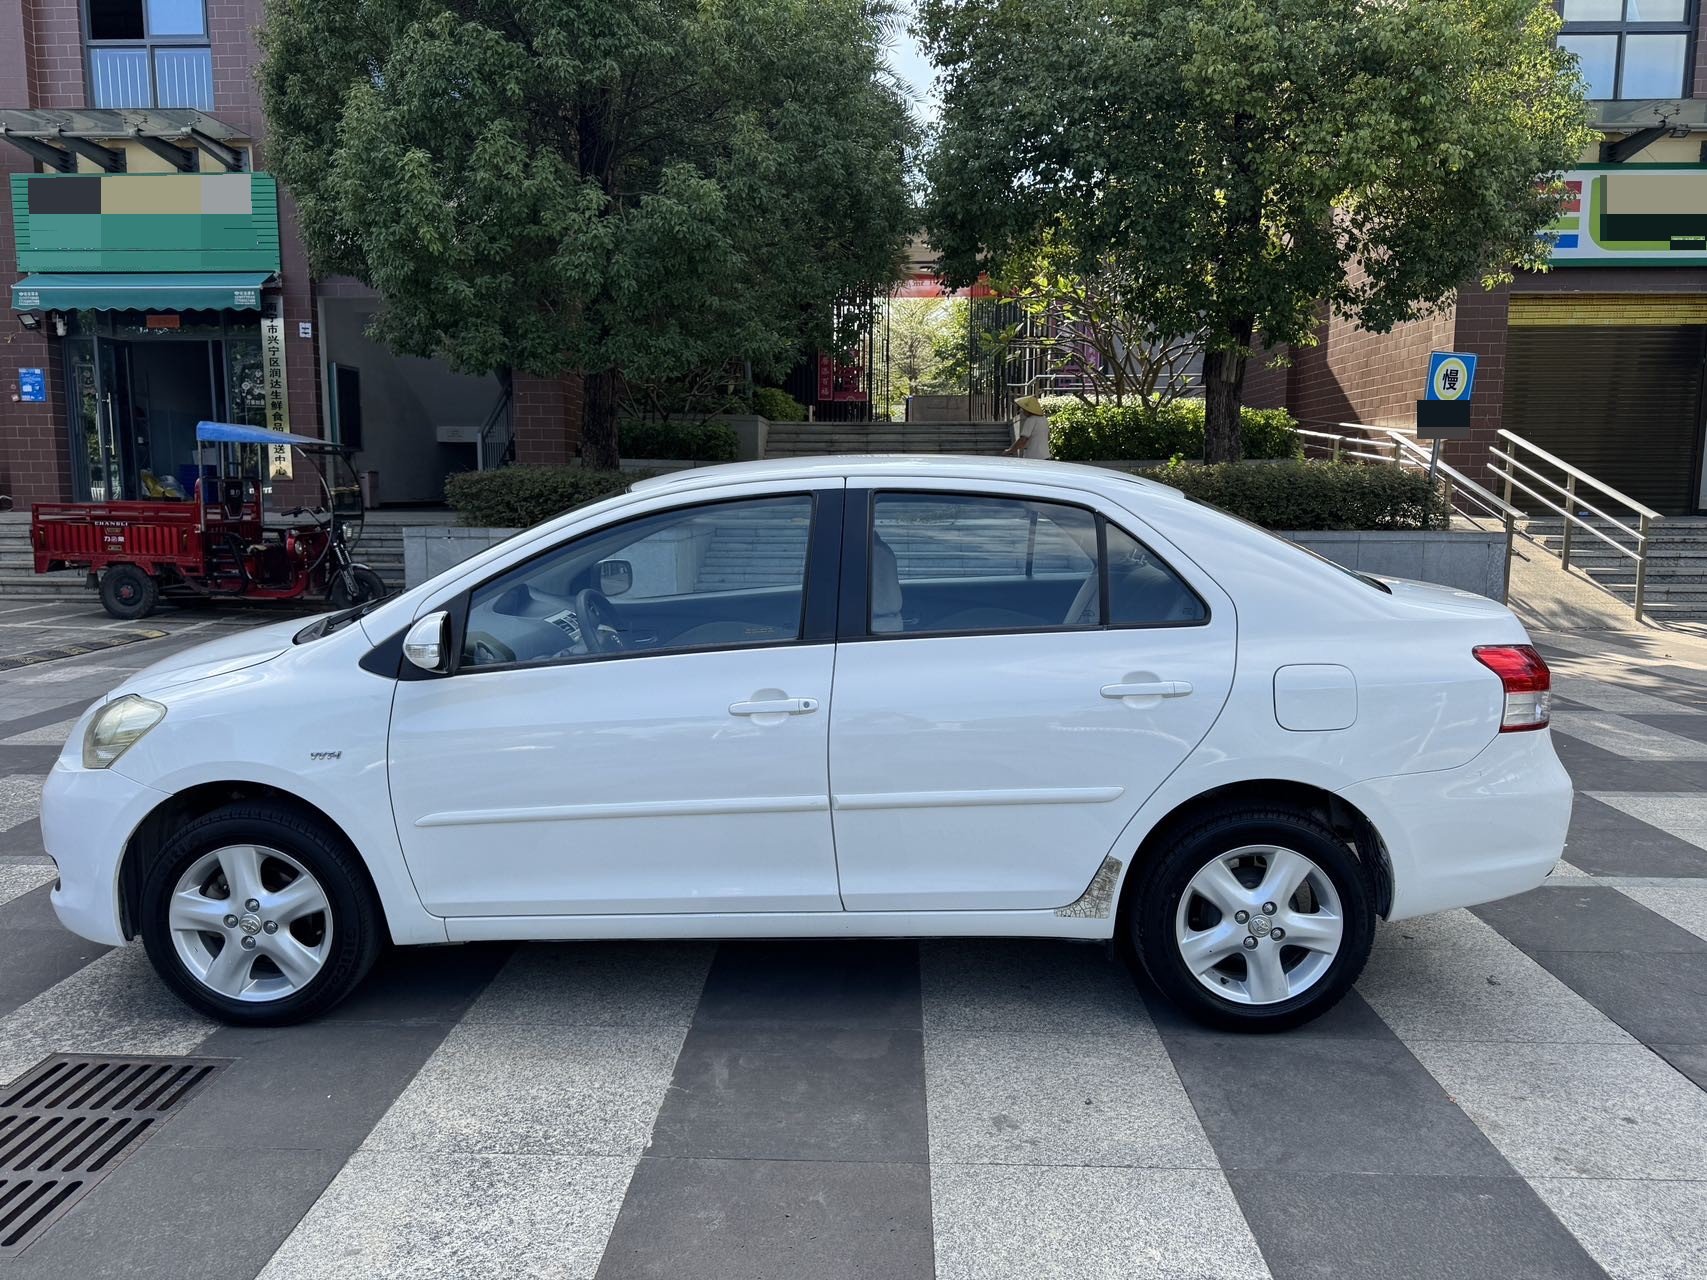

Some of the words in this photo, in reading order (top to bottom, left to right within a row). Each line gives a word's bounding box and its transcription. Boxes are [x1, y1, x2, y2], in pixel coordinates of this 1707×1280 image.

[264, 302, 288, 475] 南宁市兴宁区润达生鲜食品送中心
[1442, 368, 1459, 391] 慢
